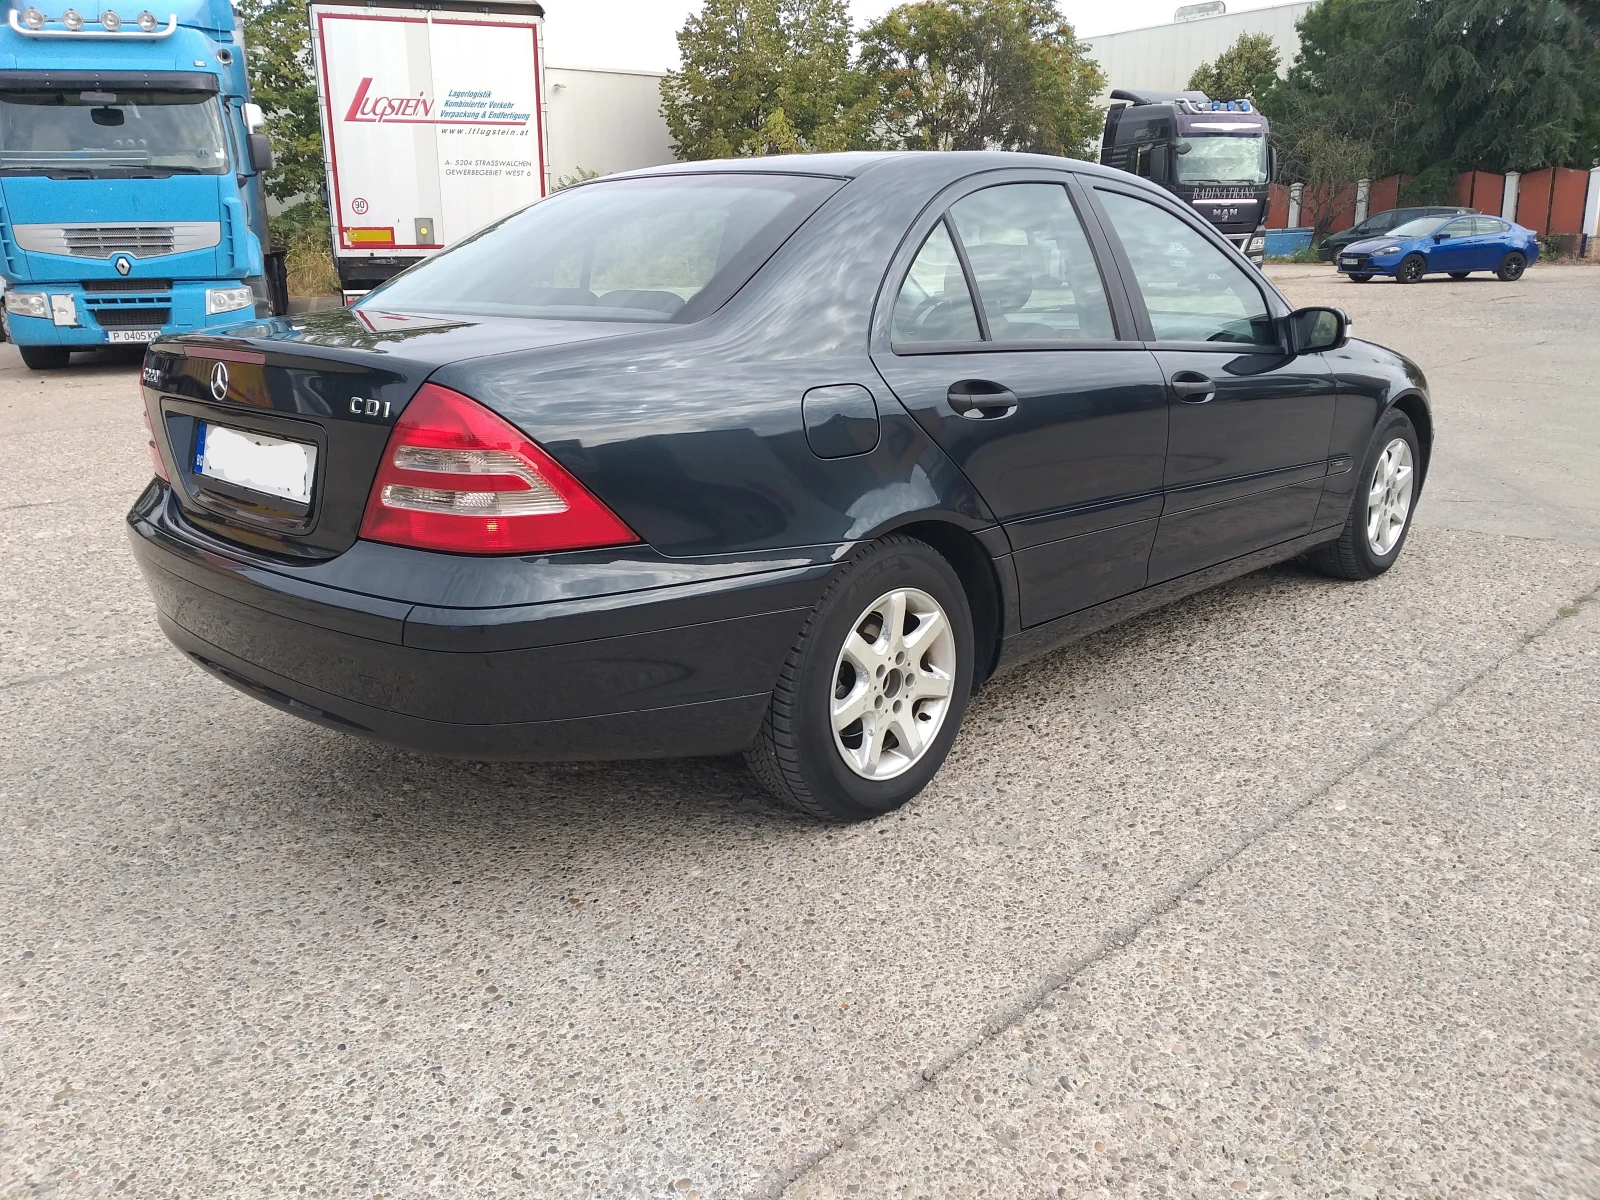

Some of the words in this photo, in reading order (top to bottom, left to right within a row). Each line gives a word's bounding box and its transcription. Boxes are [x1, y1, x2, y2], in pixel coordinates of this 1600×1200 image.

[448, 90, 492, 99] Lagerlogistik
[444, 100, 488, 108] Kombinierter
[489, 101, 515, 109] Verkehr
[440, 110, 480, 119] Verpackung
[481, 111, 487, 119] &
[488, 111, 531, 121] Endfertigung
[355, 200, 365, 209] 90
[1212, 208, 1238, 216] MAN
[113, 332, 120, 341] P
[350, 397, 391, 418] CDI
